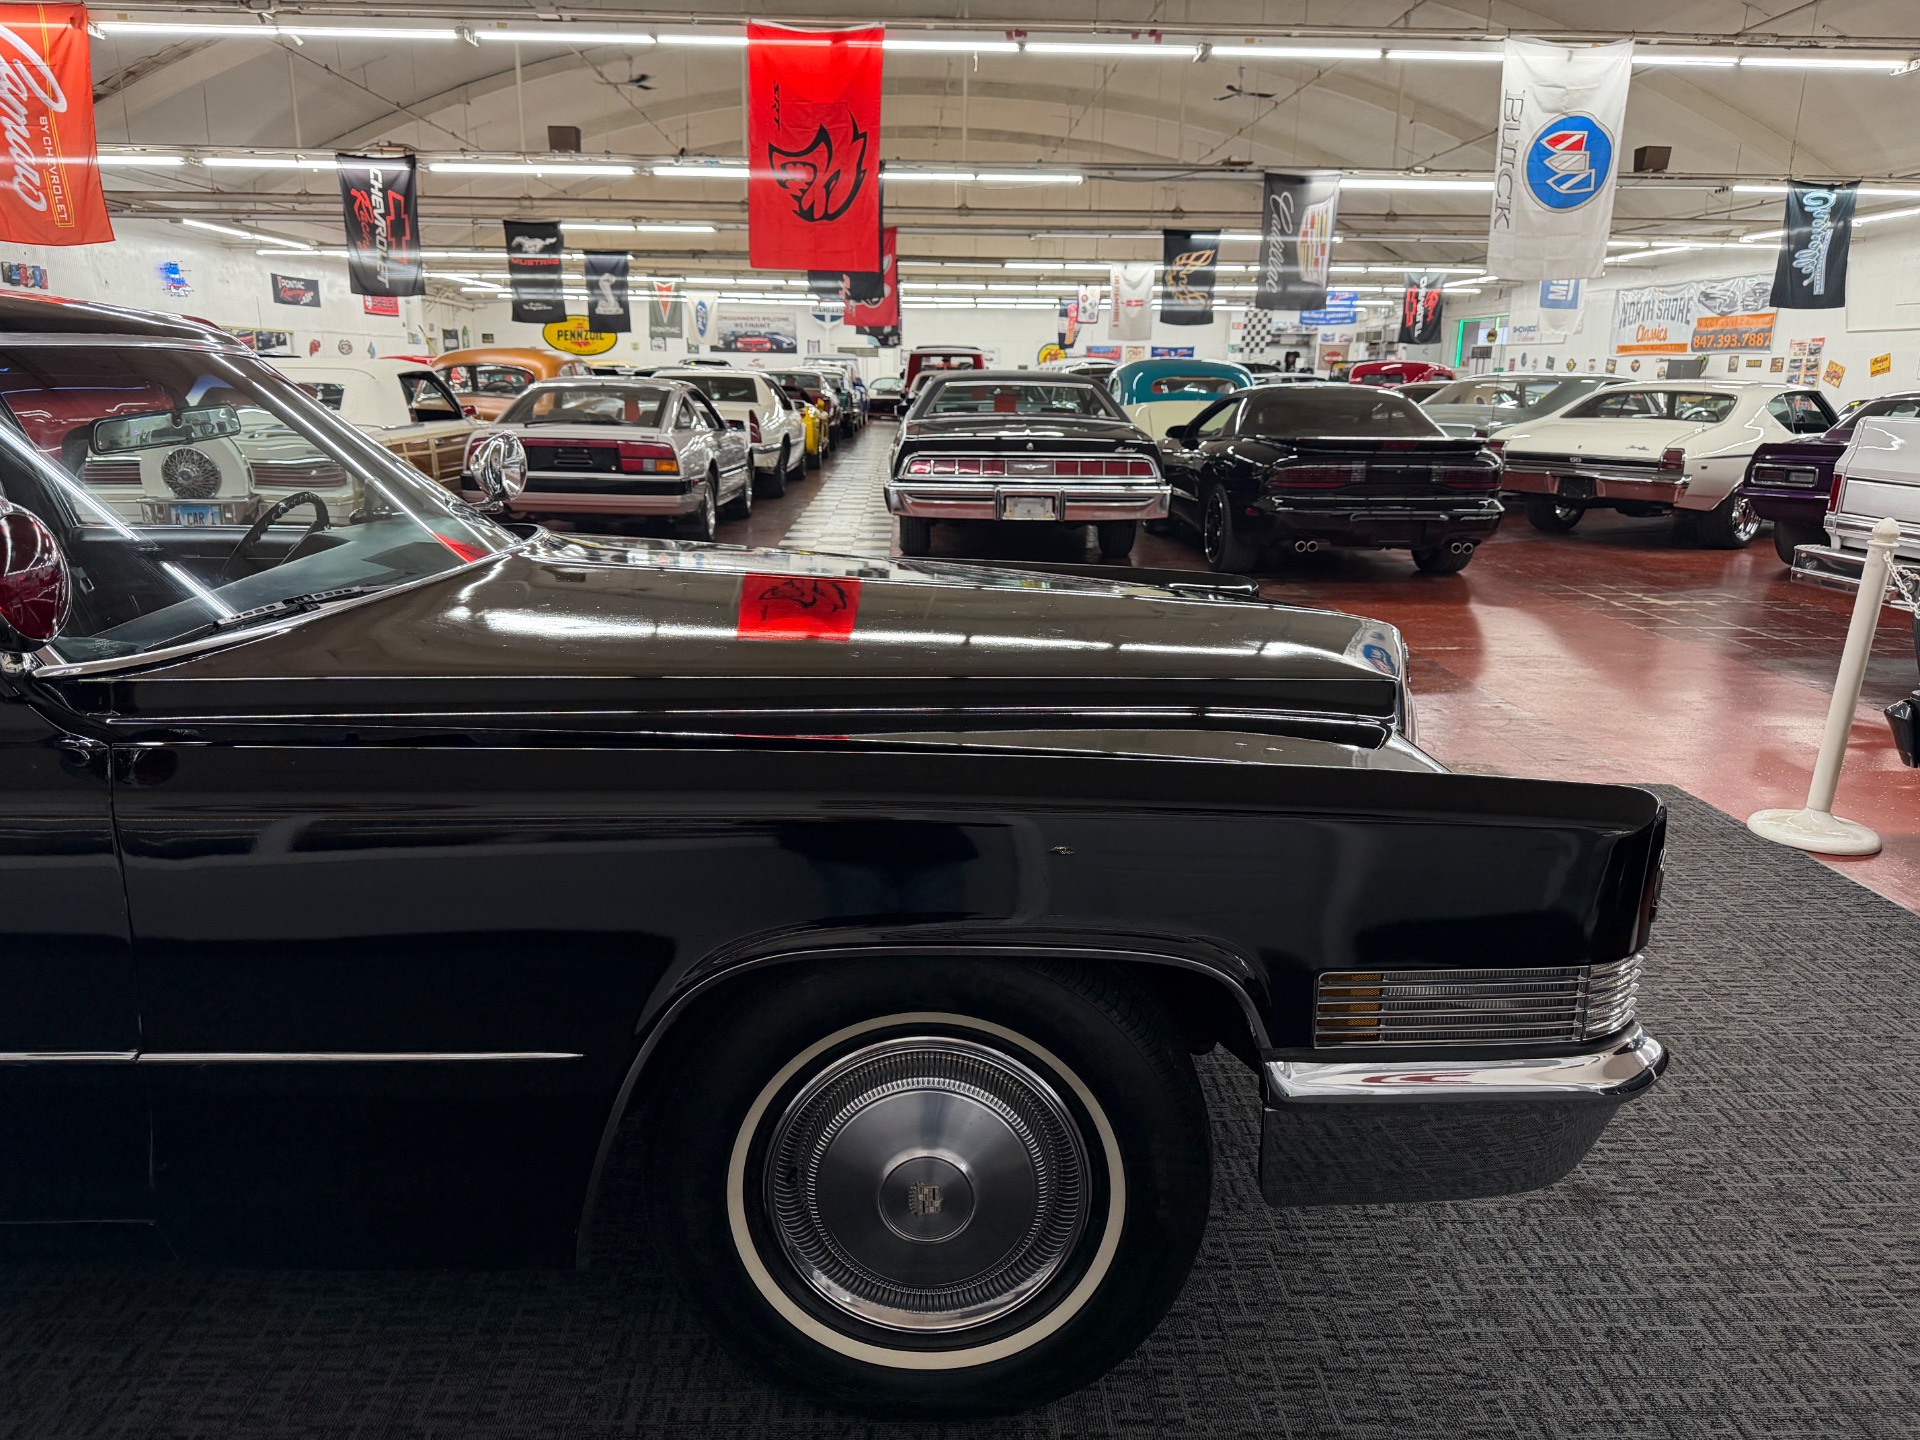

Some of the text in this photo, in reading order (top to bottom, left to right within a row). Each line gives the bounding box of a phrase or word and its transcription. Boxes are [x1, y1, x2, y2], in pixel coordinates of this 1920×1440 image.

[39, 116, 67, 221] BY CHEVROLET
[1494, 89, 1525, 229] BUICK
[370, 168, 389, 289] CHEVROLET
[1266, 191, 1294, 294] Cadillac
[511, 257, 559, 266] MUSTANG
[281, 278, 305, 290] PONTIAC
[1618, 296, 1694, 330] NORTH SHORE
[557, 329, 604, 341] PENNZOIL
[651, 325, 680, 334] PONTIAC
[1636, 323, 1668, 343] Classics
[1693, 331, 1772, 349] 847.393.7887
[175, 512, 181, 525] K
[187, 512, 205, 525] CAR
